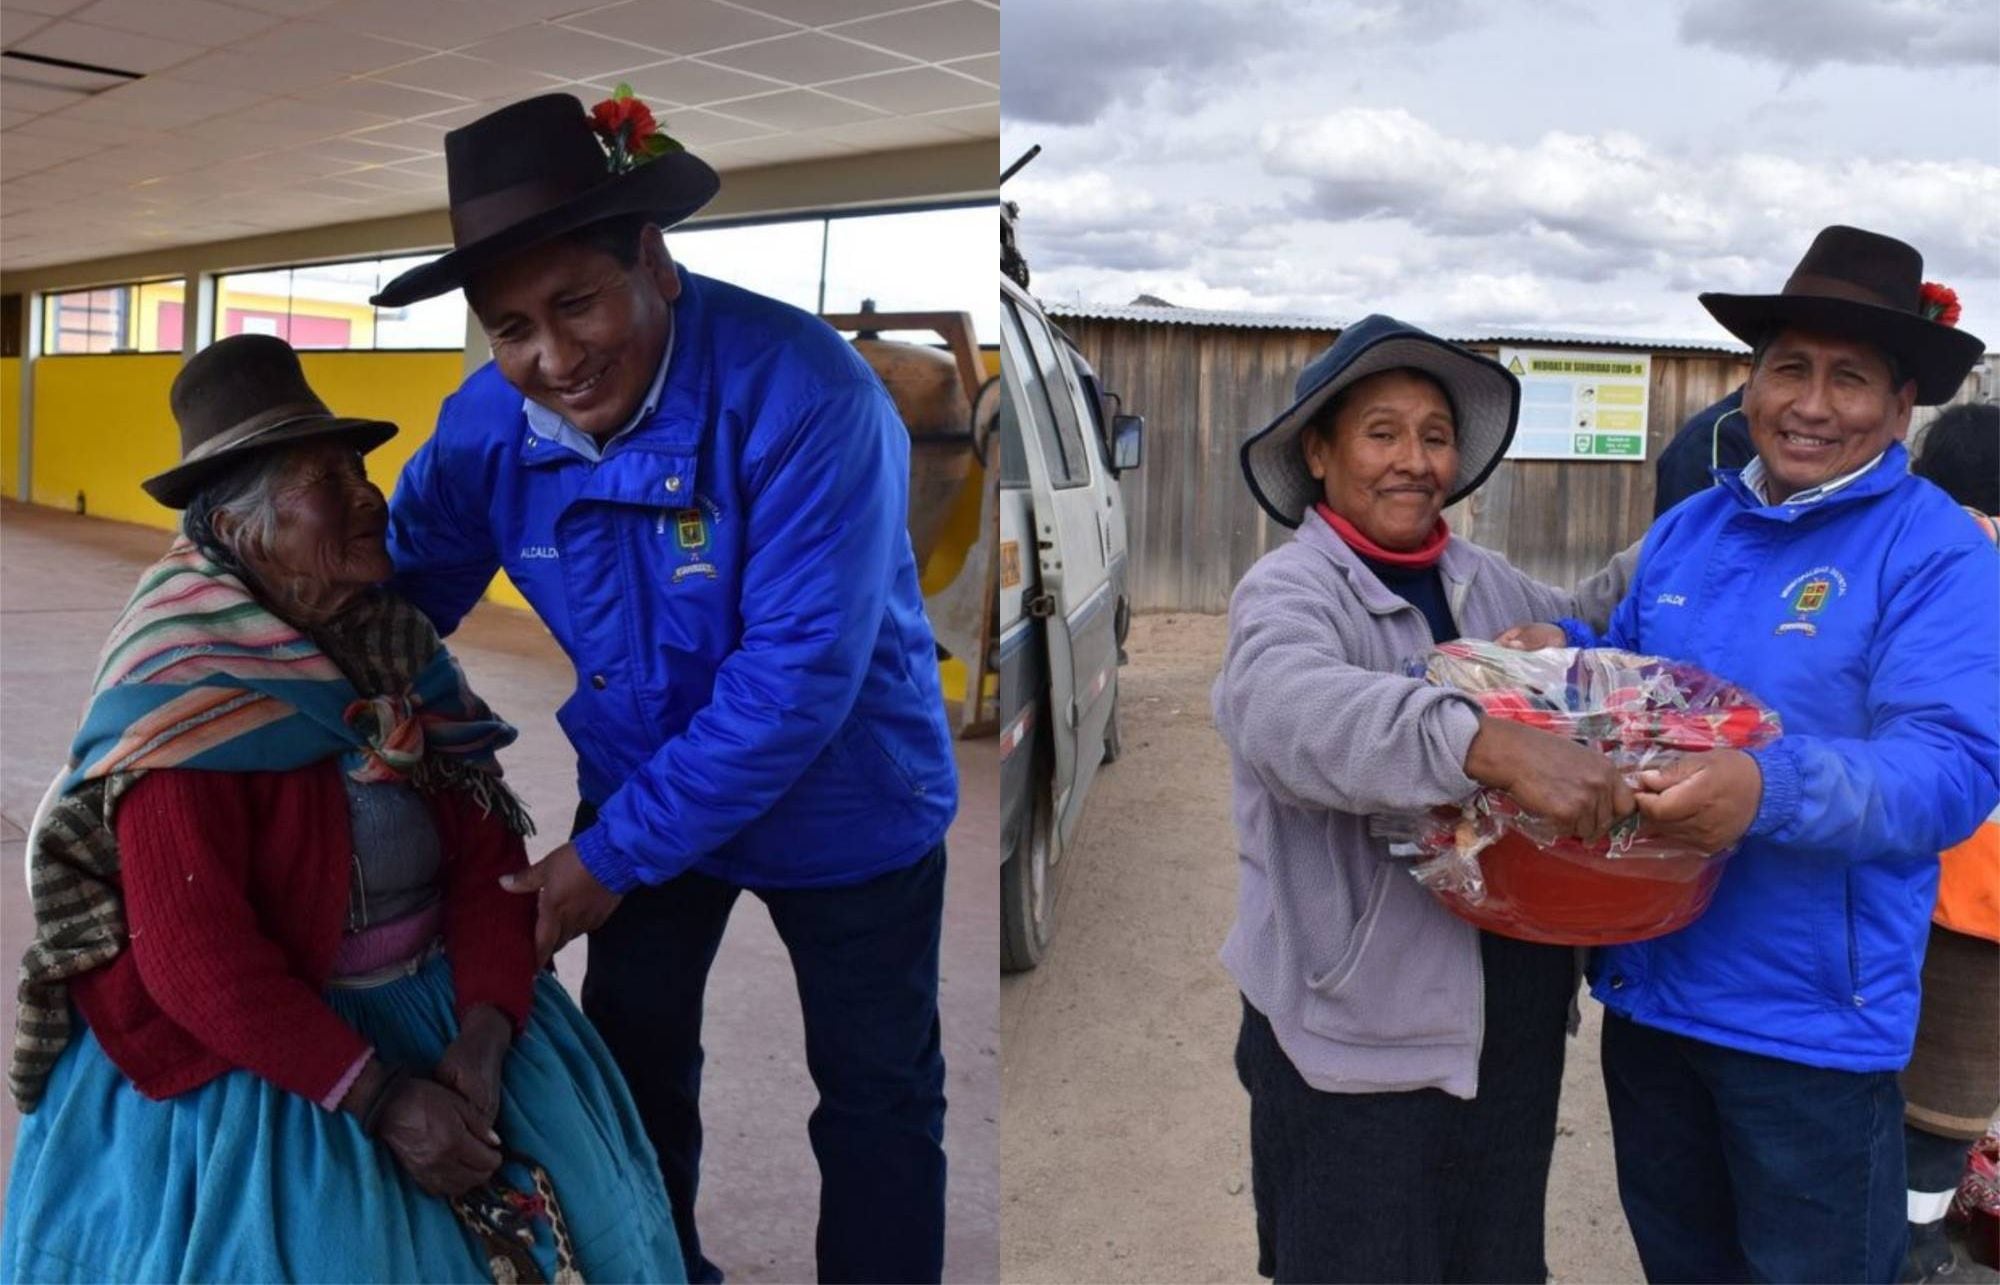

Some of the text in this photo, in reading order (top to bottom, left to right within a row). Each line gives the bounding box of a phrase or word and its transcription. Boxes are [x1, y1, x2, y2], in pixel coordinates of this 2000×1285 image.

[1533, 361, 1562, 371] MEDIDAS
[1564, 361, 1572, 372] DE
[1574, 362, 1611, 373] SEGURIDAD
